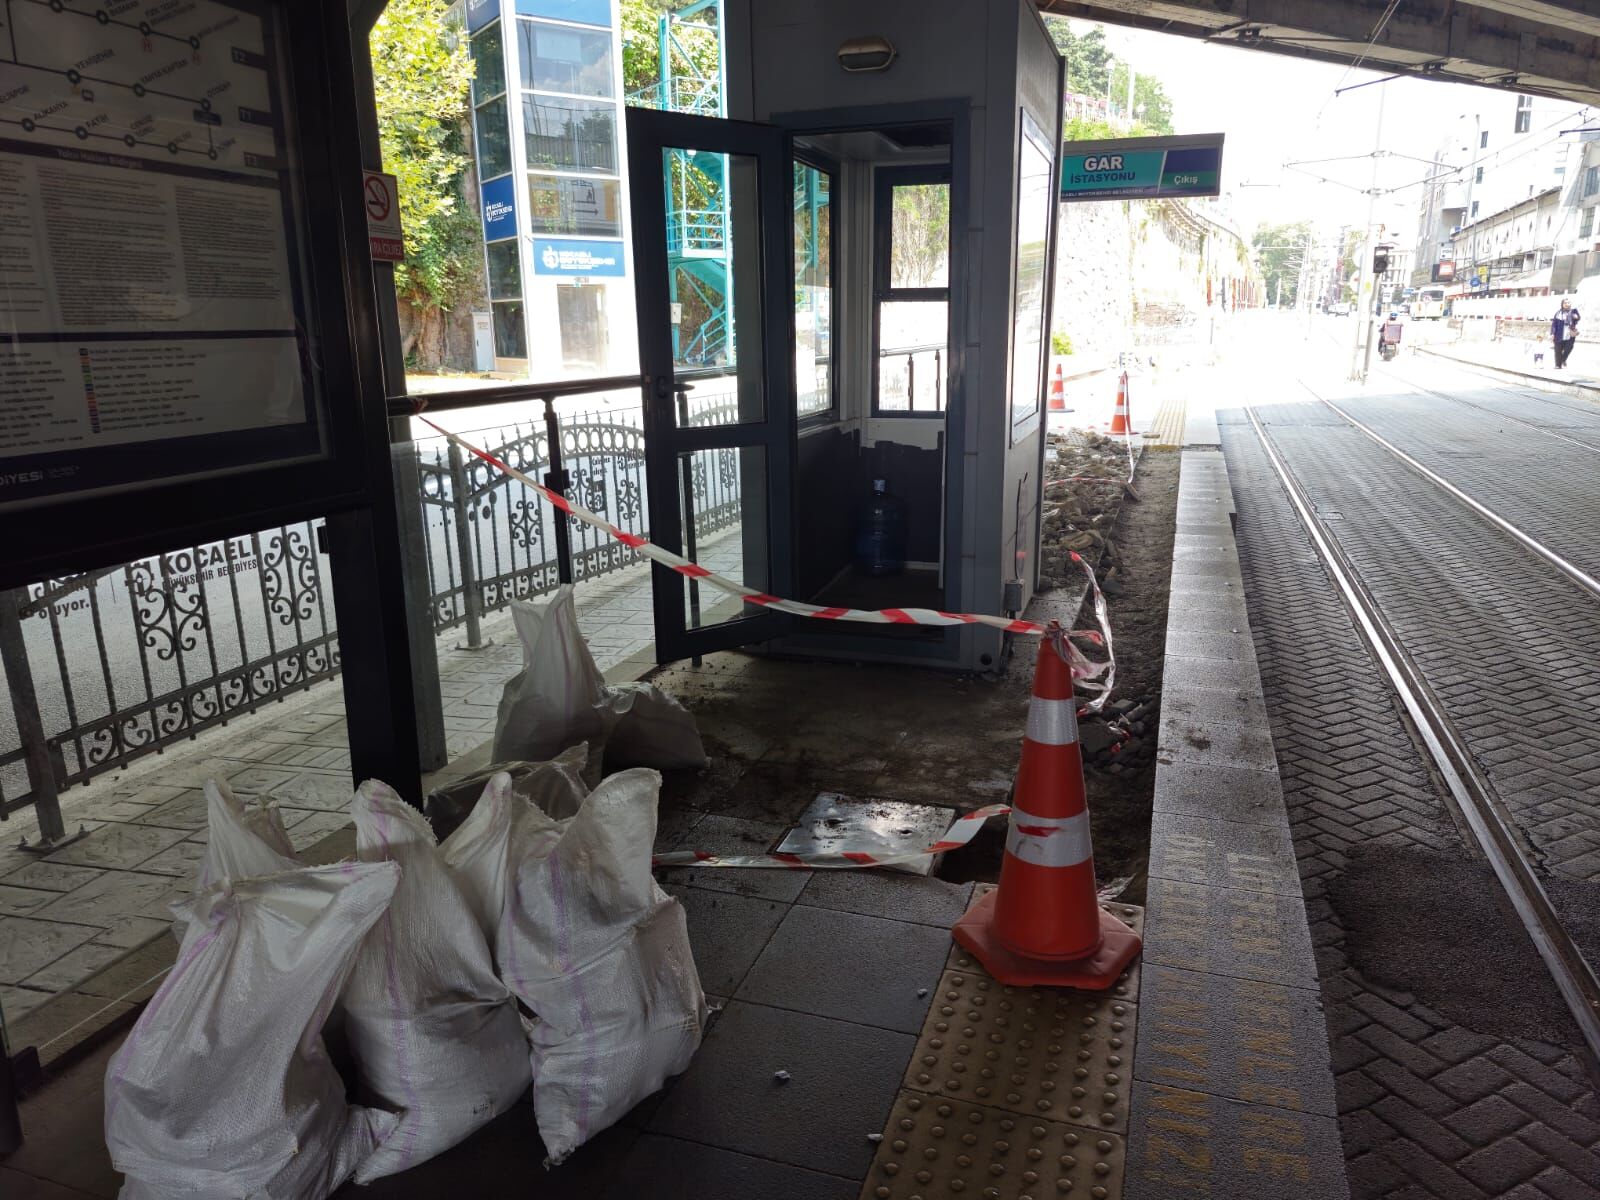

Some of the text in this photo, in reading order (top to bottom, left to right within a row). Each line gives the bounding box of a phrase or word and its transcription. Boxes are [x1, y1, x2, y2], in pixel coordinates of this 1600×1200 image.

[1084, 155, 1123, 172] GAR
[1070, 172, 1136, 185] İSTASYONU
[1174, 175, 1199, 186] Çıkış
[39, 600, 90, 620] ouyor.
